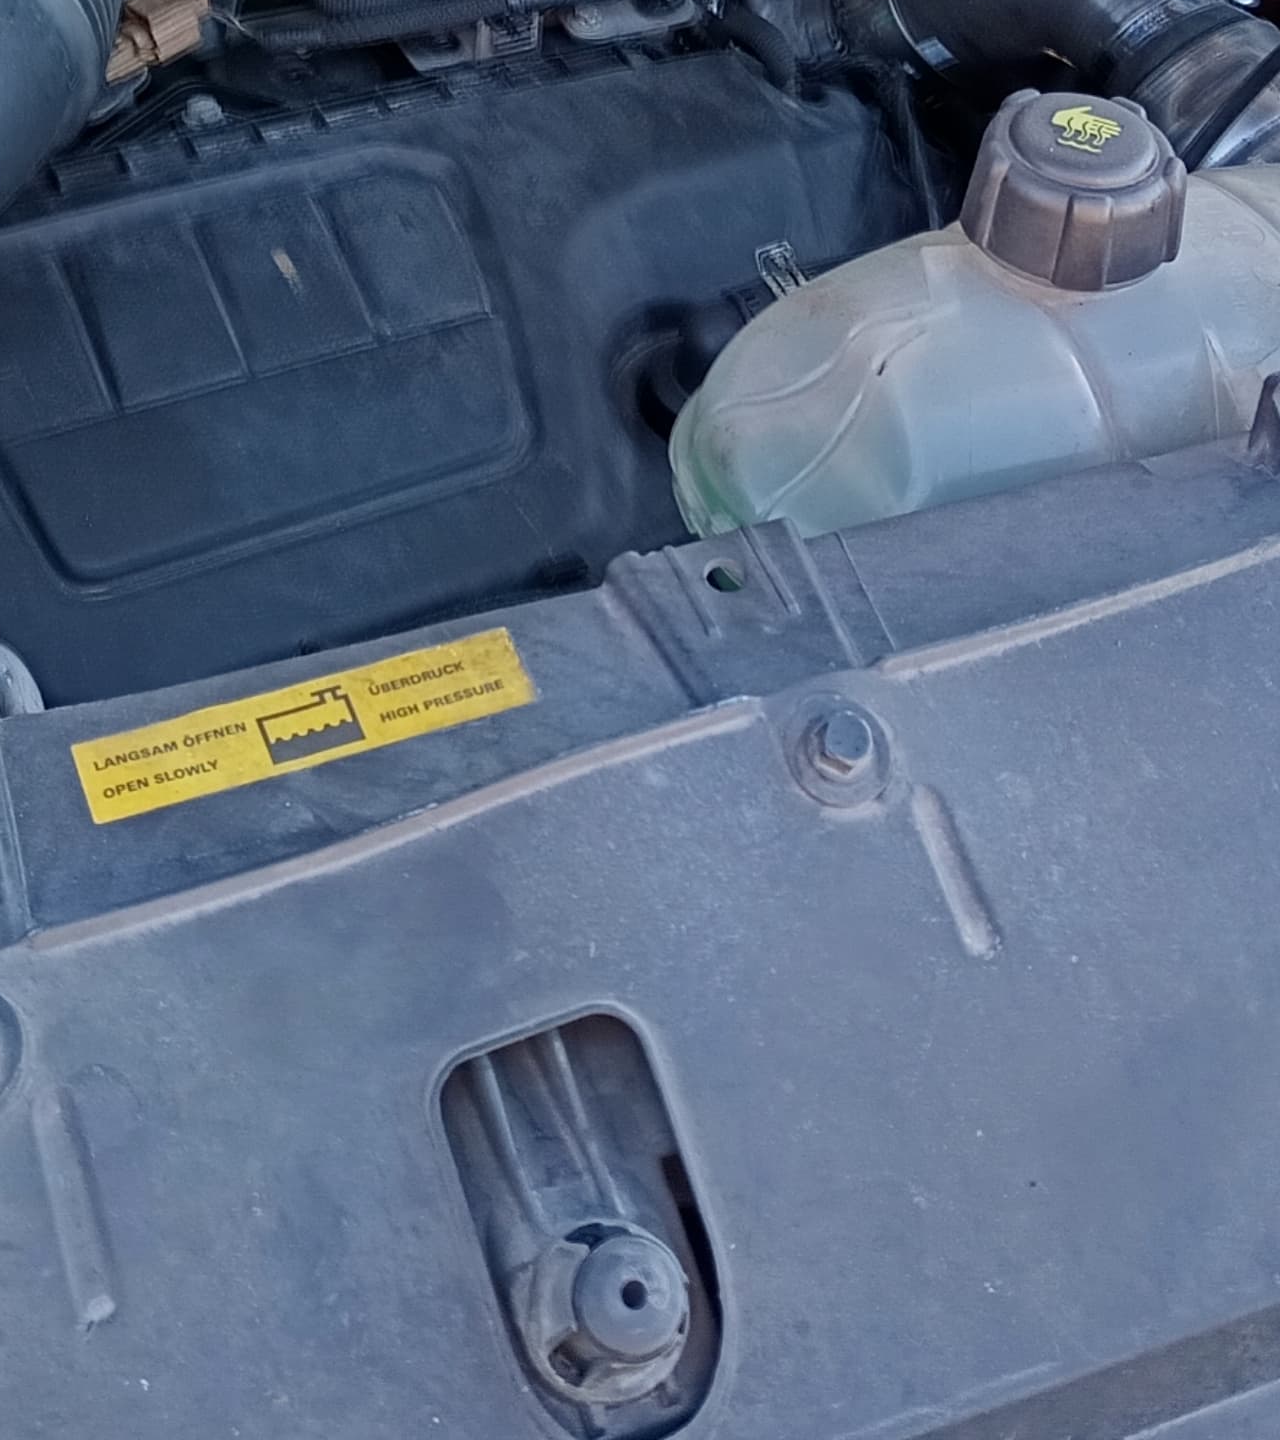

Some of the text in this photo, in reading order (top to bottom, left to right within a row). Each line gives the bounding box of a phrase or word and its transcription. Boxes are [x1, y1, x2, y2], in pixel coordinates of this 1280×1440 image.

[368, 661, 465, 697] ÜBERDRUCK
[378, 678, 505, 724] HIGH PRESSURE
[92, 720, 247, 772] LANGSAM ÖFFNEN
[102, 759, 219, 800] OPEN SLOWLY
